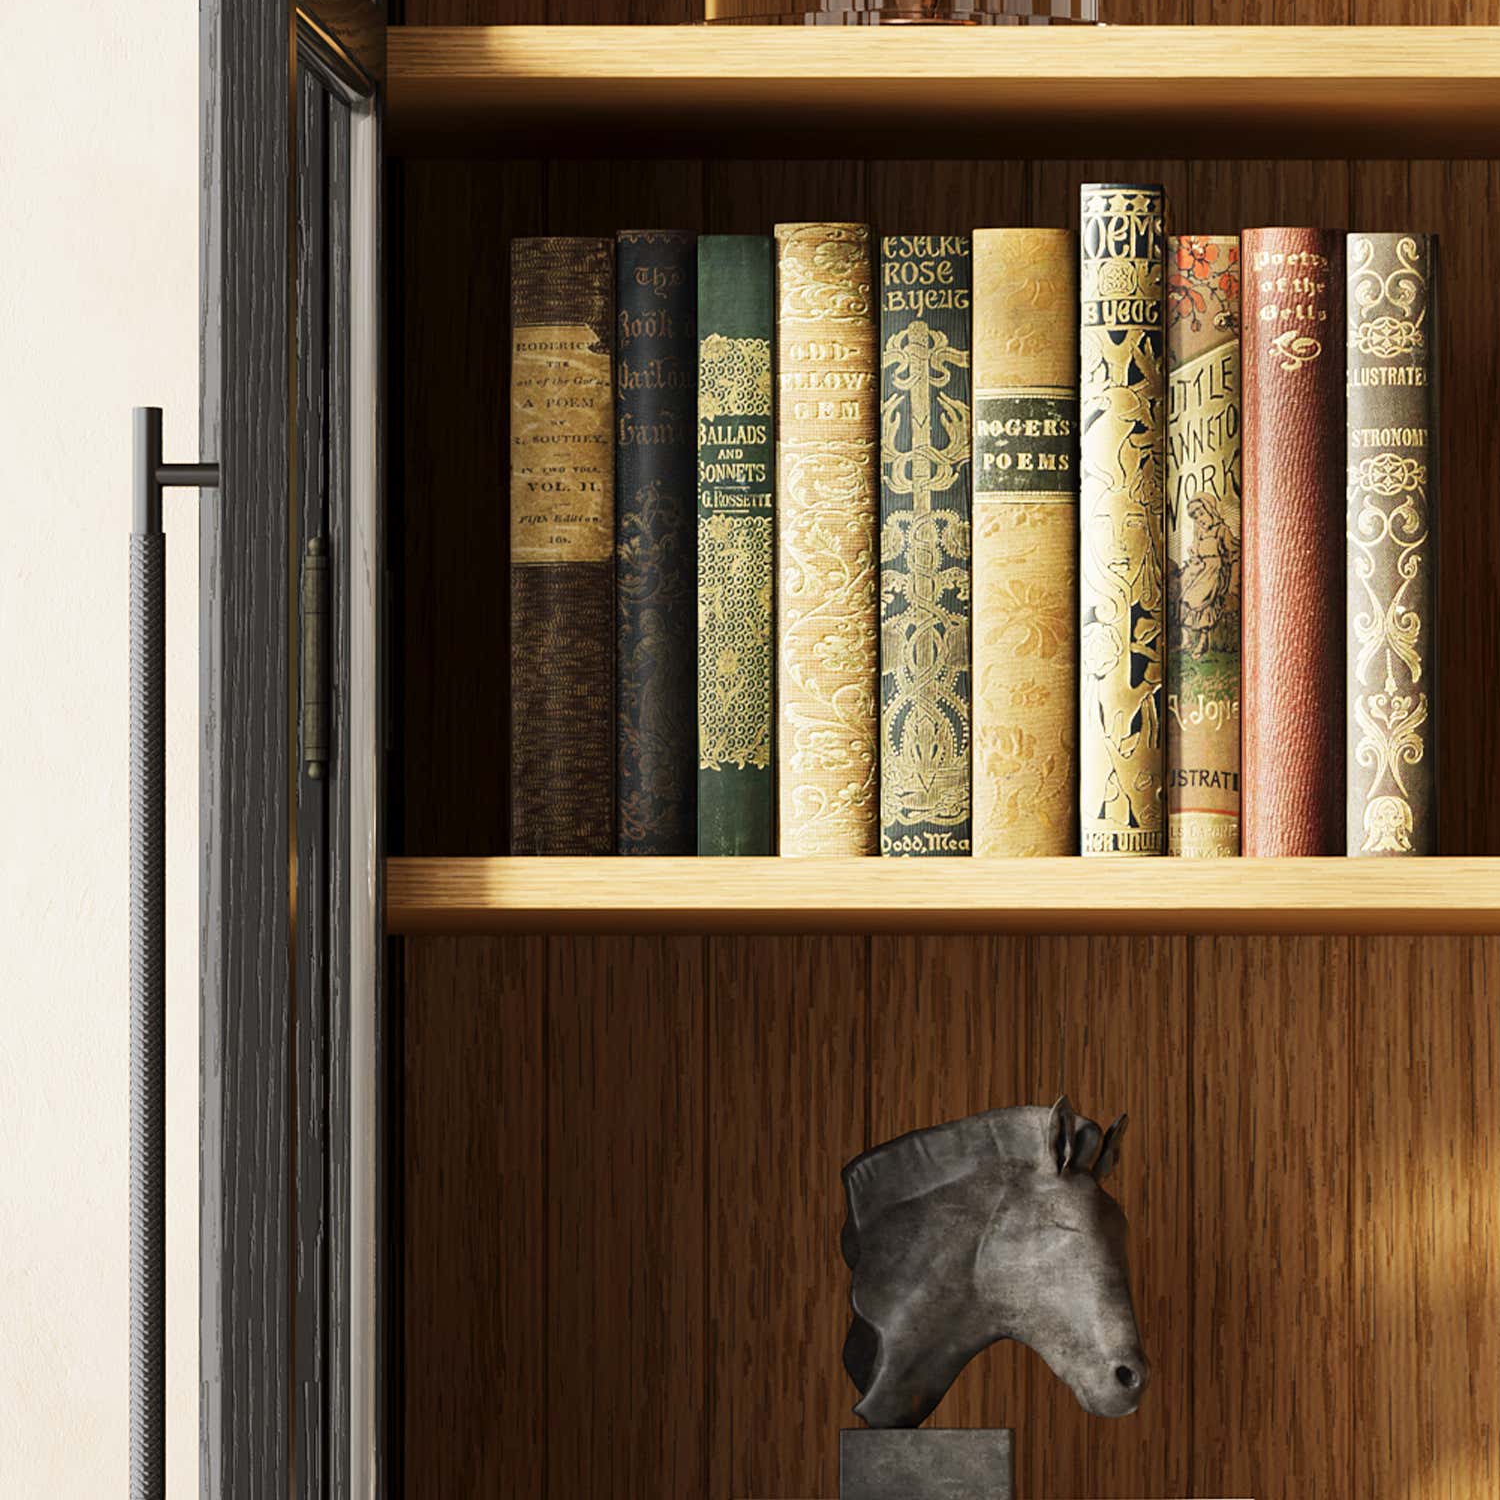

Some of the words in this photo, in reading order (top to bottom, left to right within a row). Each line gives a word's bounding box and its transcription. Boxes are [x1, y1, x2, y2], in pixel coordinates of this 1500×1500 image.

[515, 341, 590, 352] RODERIC
[521, 398, 534, 409] A
[546, 398, 594, 409] POEM
[699, 422, 767, 445] BALLADS
[717, 448, 744, 460] AND
[983, 453, 1069, 471] POEMS
[699, 461, 766, 483] SONNETS
